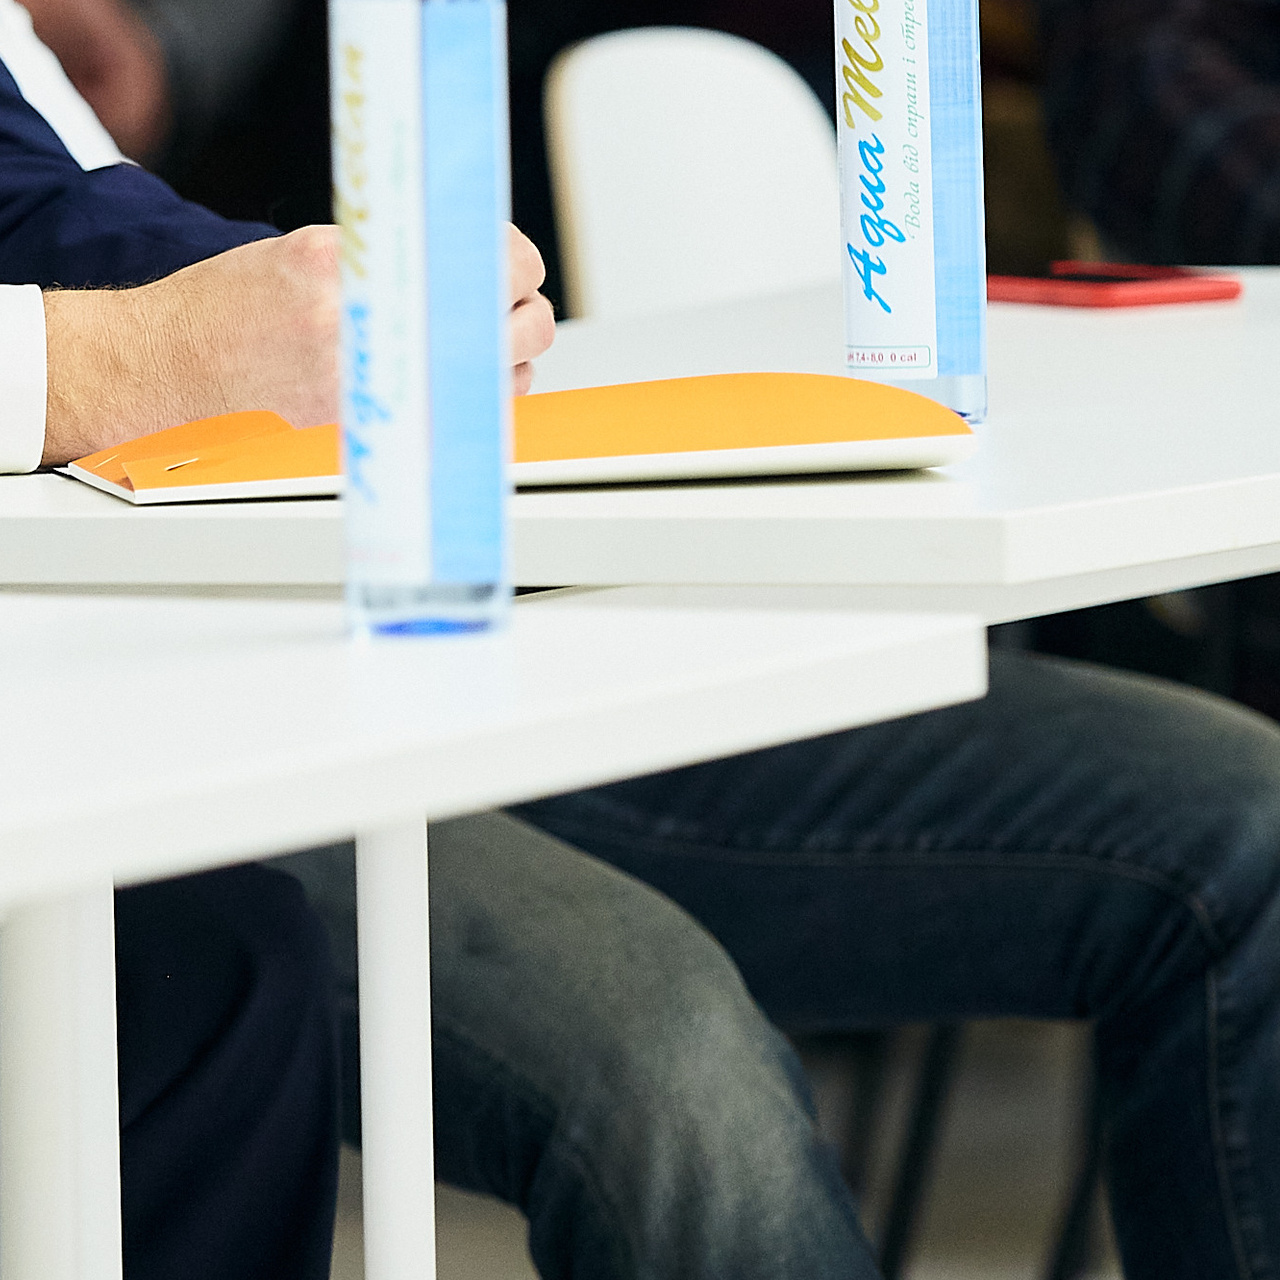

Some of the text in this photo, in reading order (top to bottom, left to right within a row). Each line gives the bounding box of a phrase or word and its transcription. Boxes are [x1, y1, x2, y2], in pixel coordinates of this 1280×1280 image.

[902, 143, 920, 174] від
[847, 133, 907, 314] Aqua
[903, 181, 921, 239] Вода
